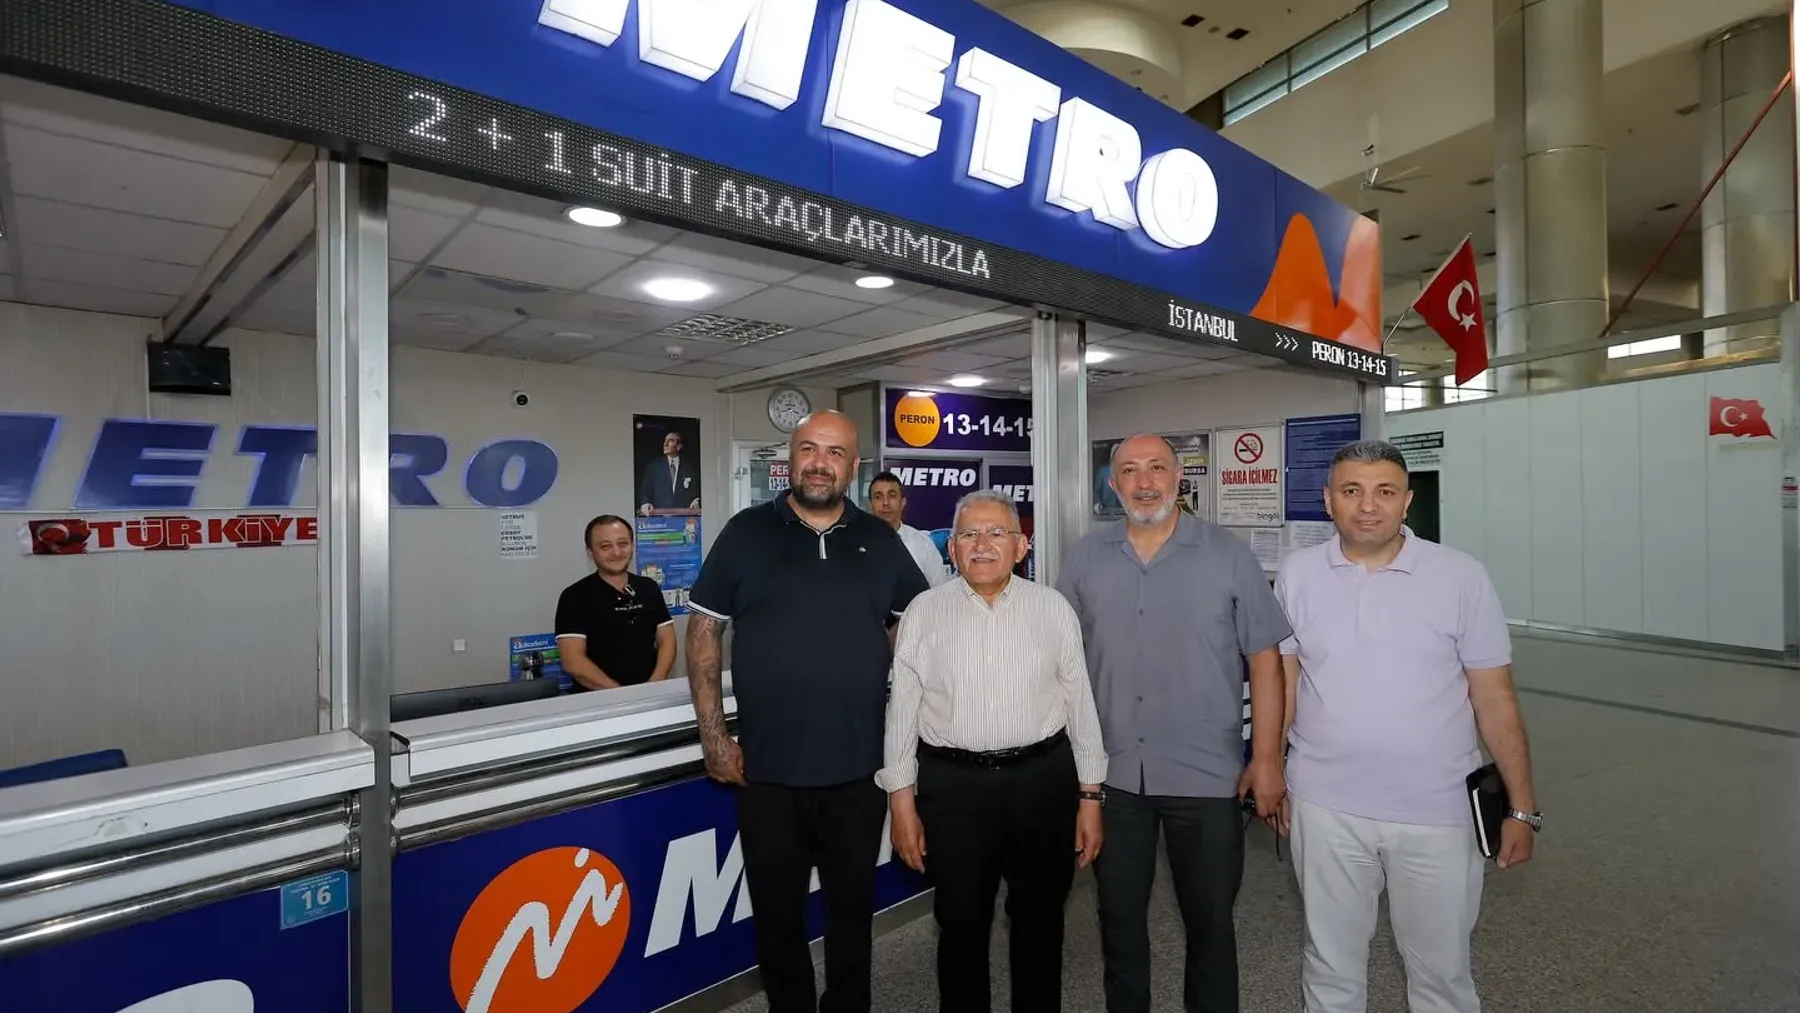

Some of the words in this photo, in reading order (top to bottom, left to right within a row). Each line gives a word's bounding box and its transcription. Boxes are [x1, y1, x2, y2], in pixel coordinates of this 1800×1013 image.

[408, 91, 447, 142] 2
[544, 131, 572, 174] 1
[715, 179, 991, 279] ARAÇLARIMIZLA
[1168, 300, 1239, 343] İSTANBUL
[1311, 340, 1345, 366] PERON
[1347, 350, 1387, 376] 13-14-15
[900, 413, 935, 425] PERON
[769, 464, 789, 476] PER
[889, 466, 977, 487] METRO
[1248, 467, 1278, 485] İÇİLMEZ
[88, 515, 317, 549] TÜRKİYE
[302, 885, 331, 910] 16
